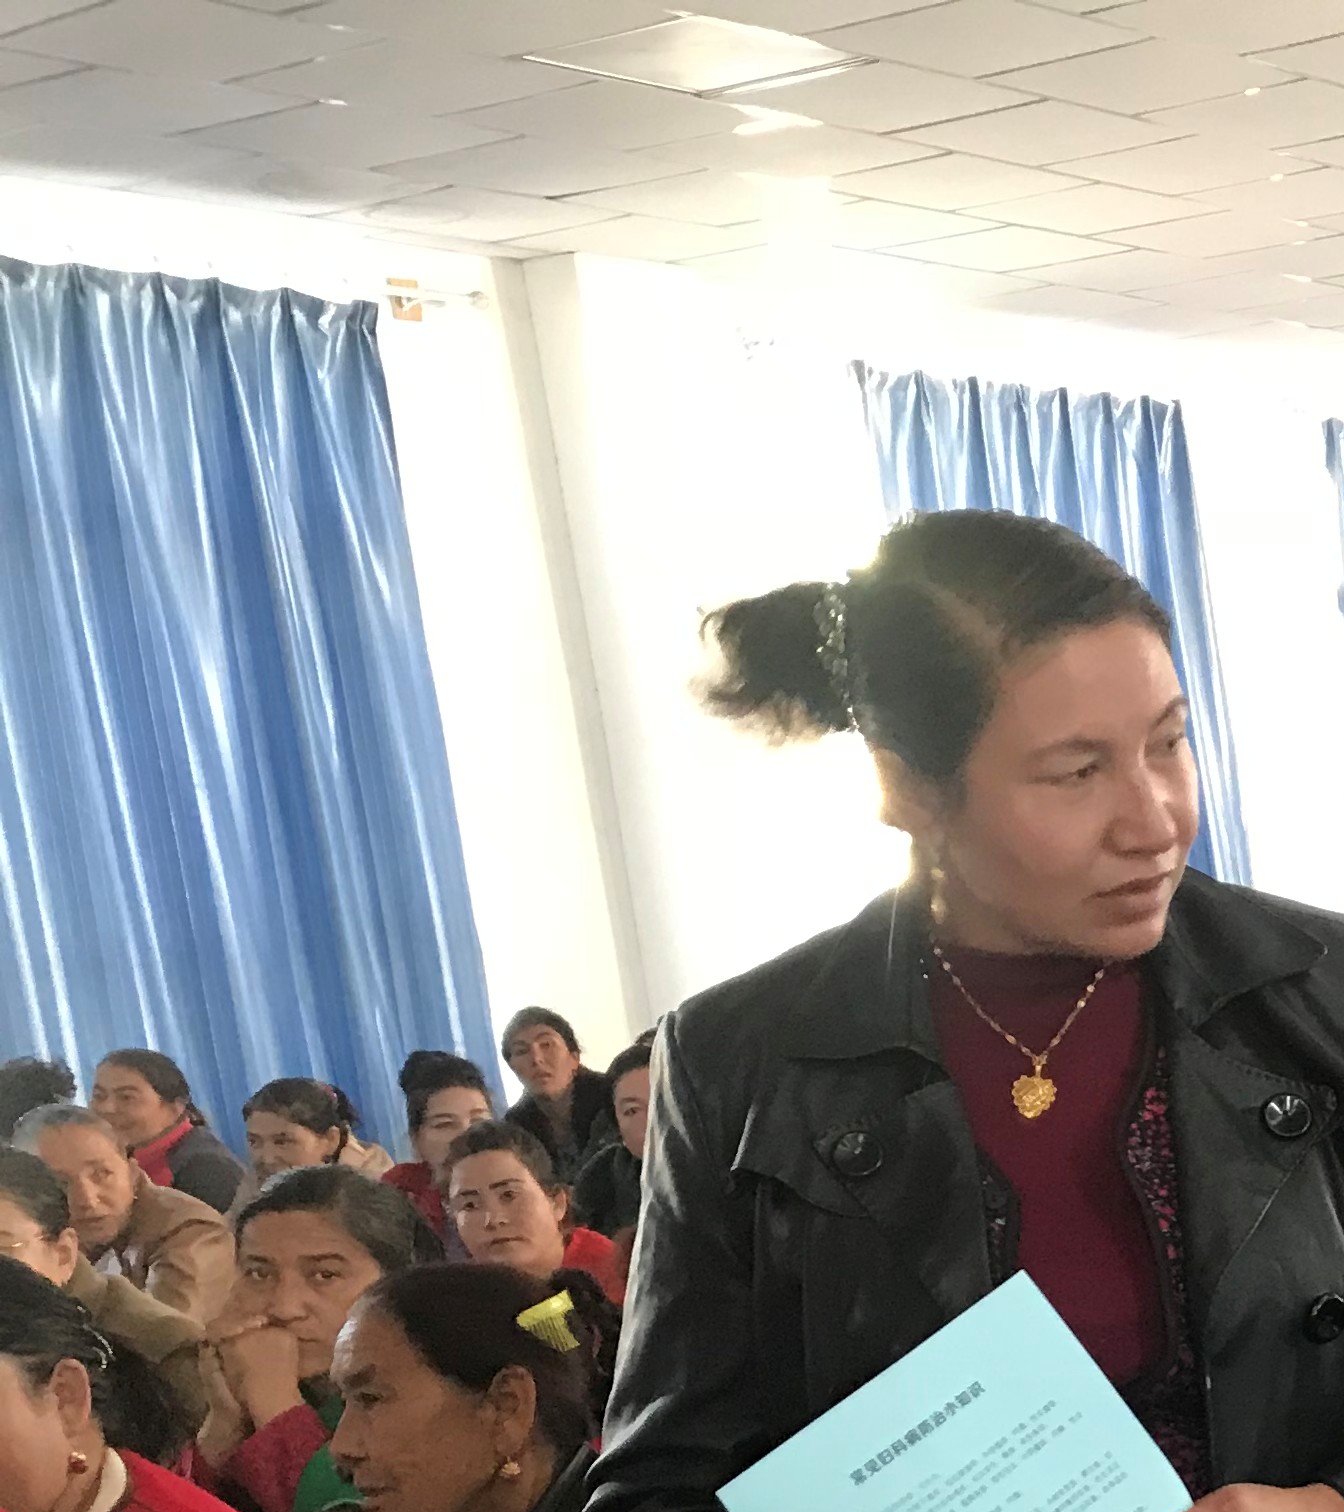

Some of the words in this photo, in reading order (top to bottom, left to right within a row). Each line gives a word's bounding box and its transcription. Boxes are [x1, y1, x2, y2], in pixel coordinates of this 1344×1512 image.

[848, 1380, 986, 1485] 常见妇科病防治小知识
